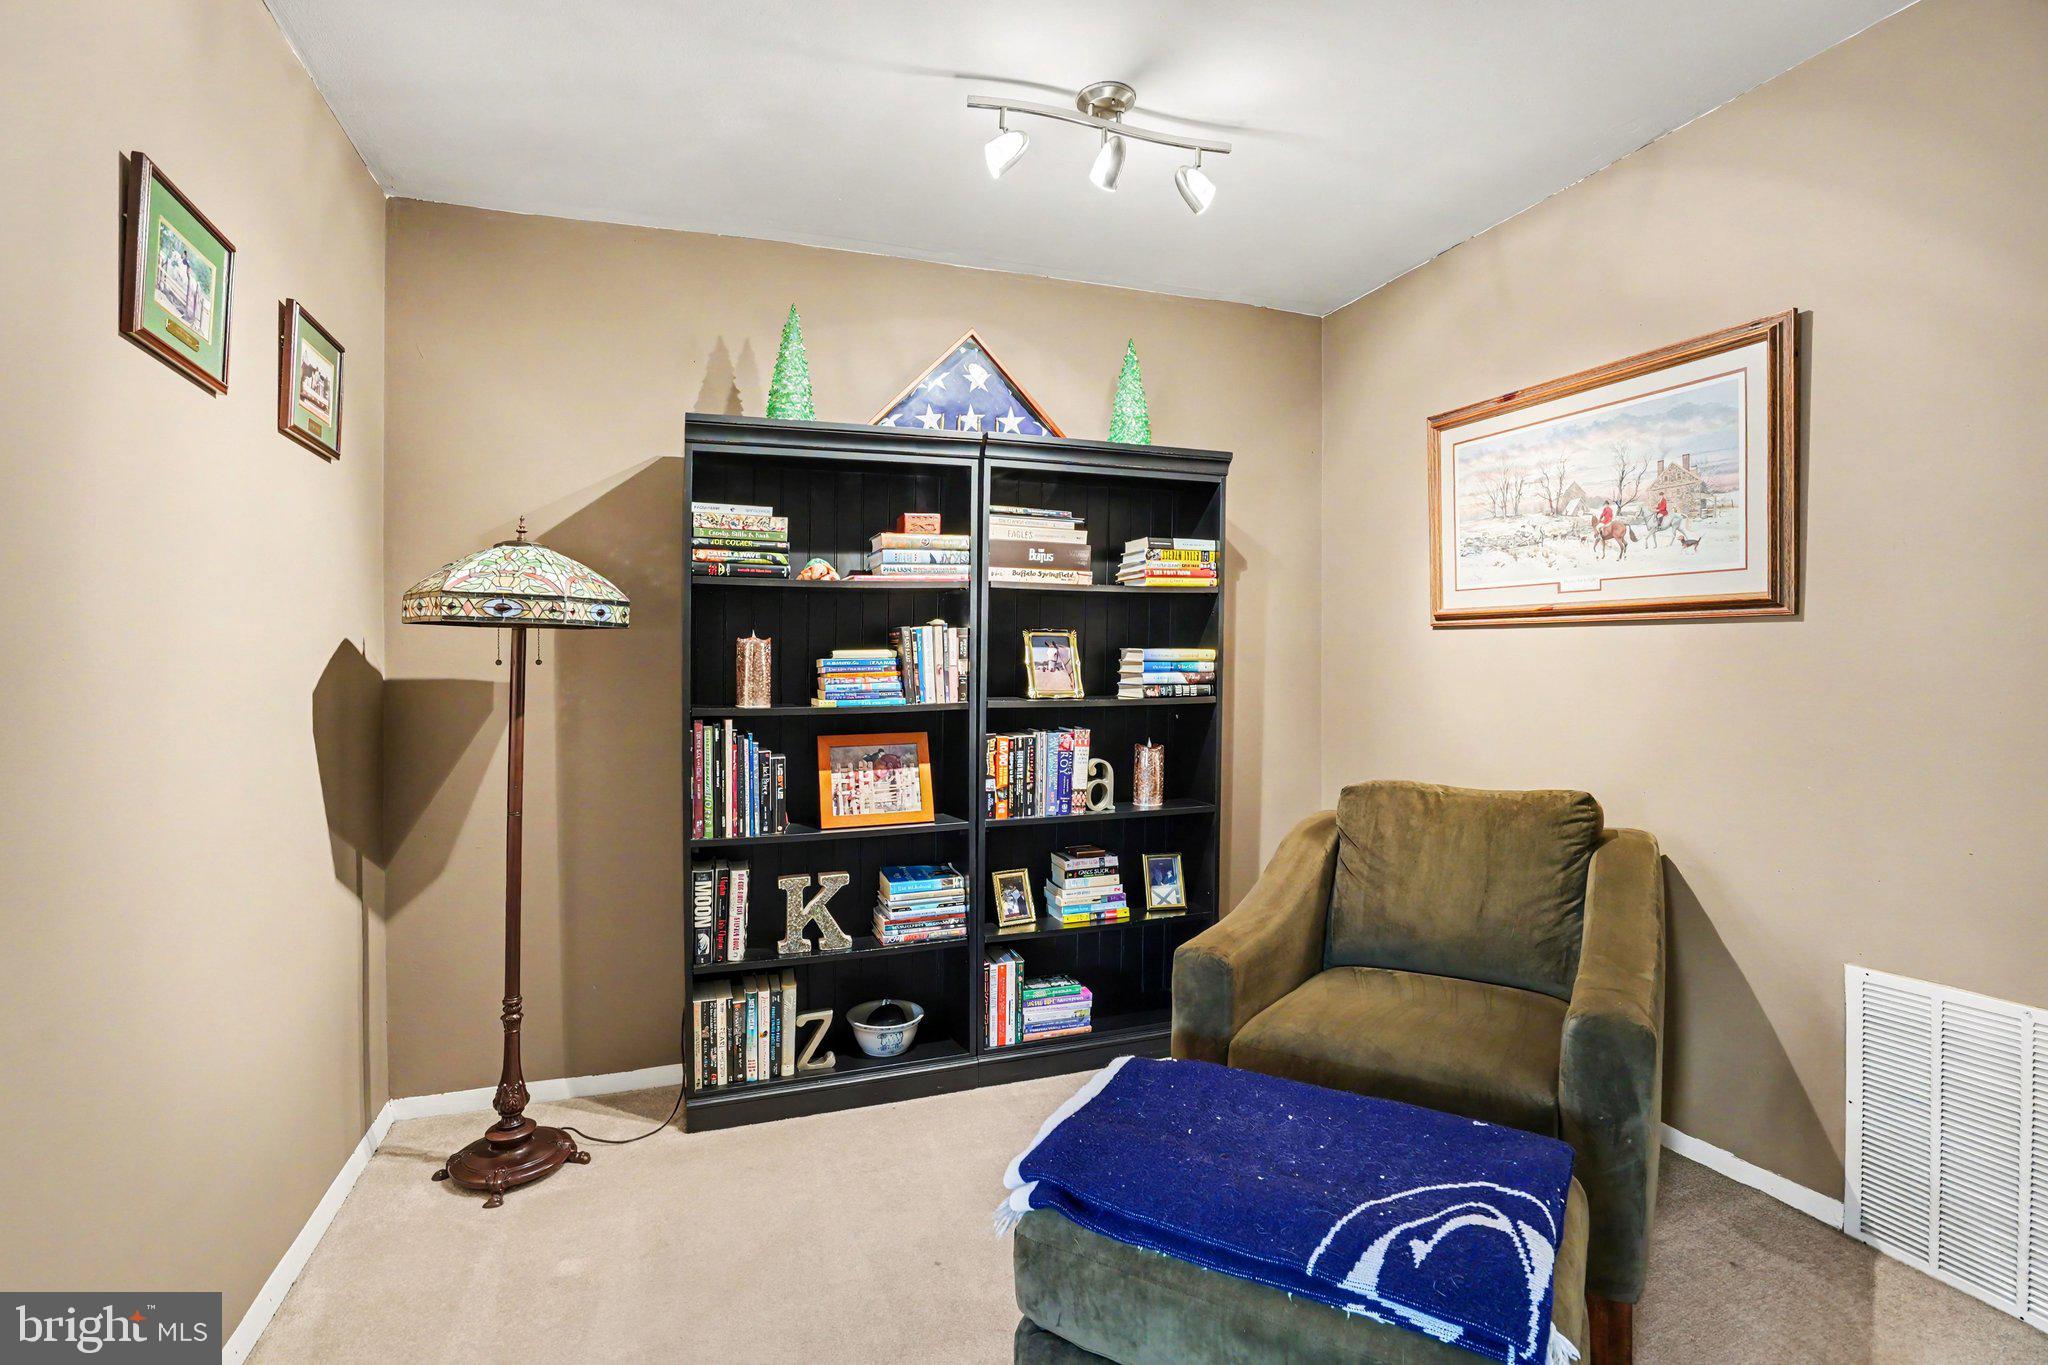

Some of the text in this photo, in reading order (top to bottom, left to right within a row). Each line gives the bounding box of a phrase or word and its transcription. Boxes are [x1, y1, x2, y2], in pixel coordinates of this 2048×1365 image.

[1012, 569, 1075, 579] Buffalo Springfield
[694, 880, 712, 928] MOON
[777, 870, 853, 954] K
